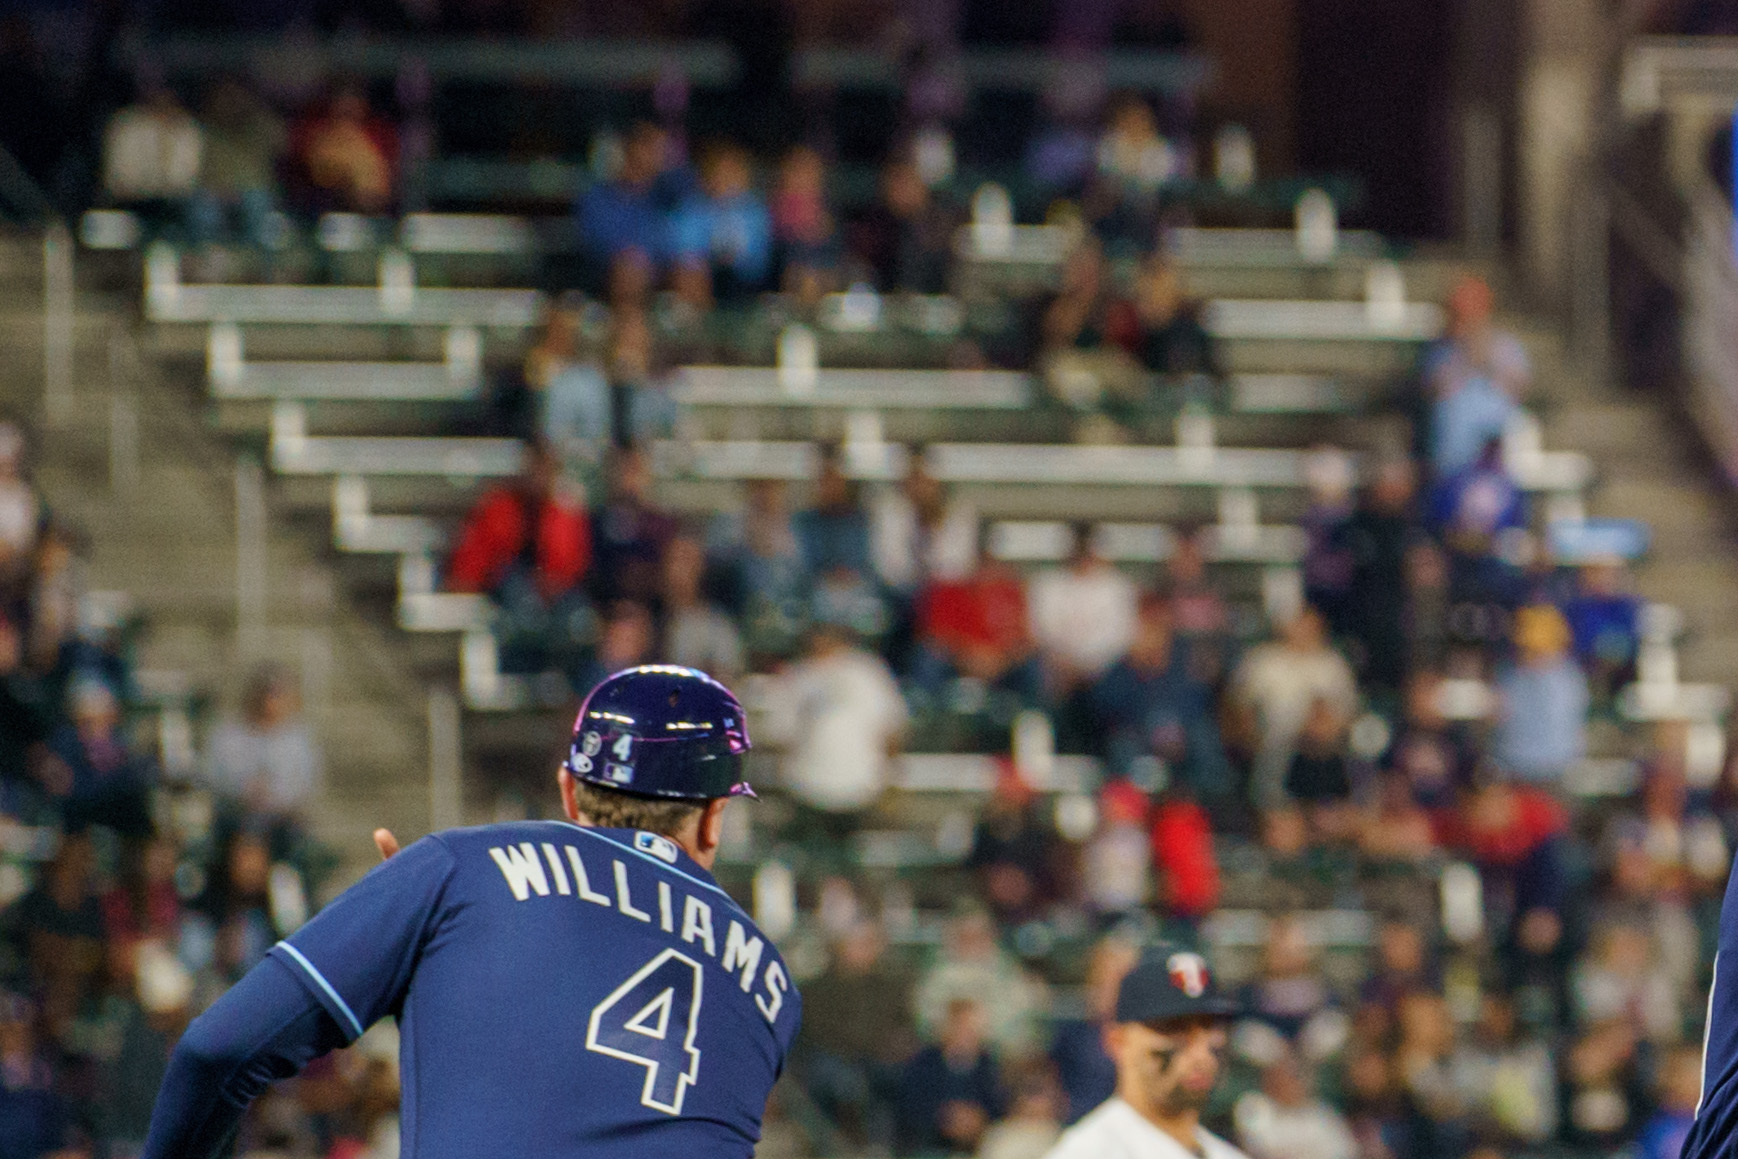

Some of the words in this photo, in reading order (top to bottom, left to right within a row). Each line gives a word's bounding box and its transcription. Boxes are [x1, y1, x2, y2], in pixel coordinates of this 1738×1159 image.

[611, 733, 633, 762] 4
[488, 842, 789, 1024] WILLIAMS
[586, 947, 703, 1116] 4
